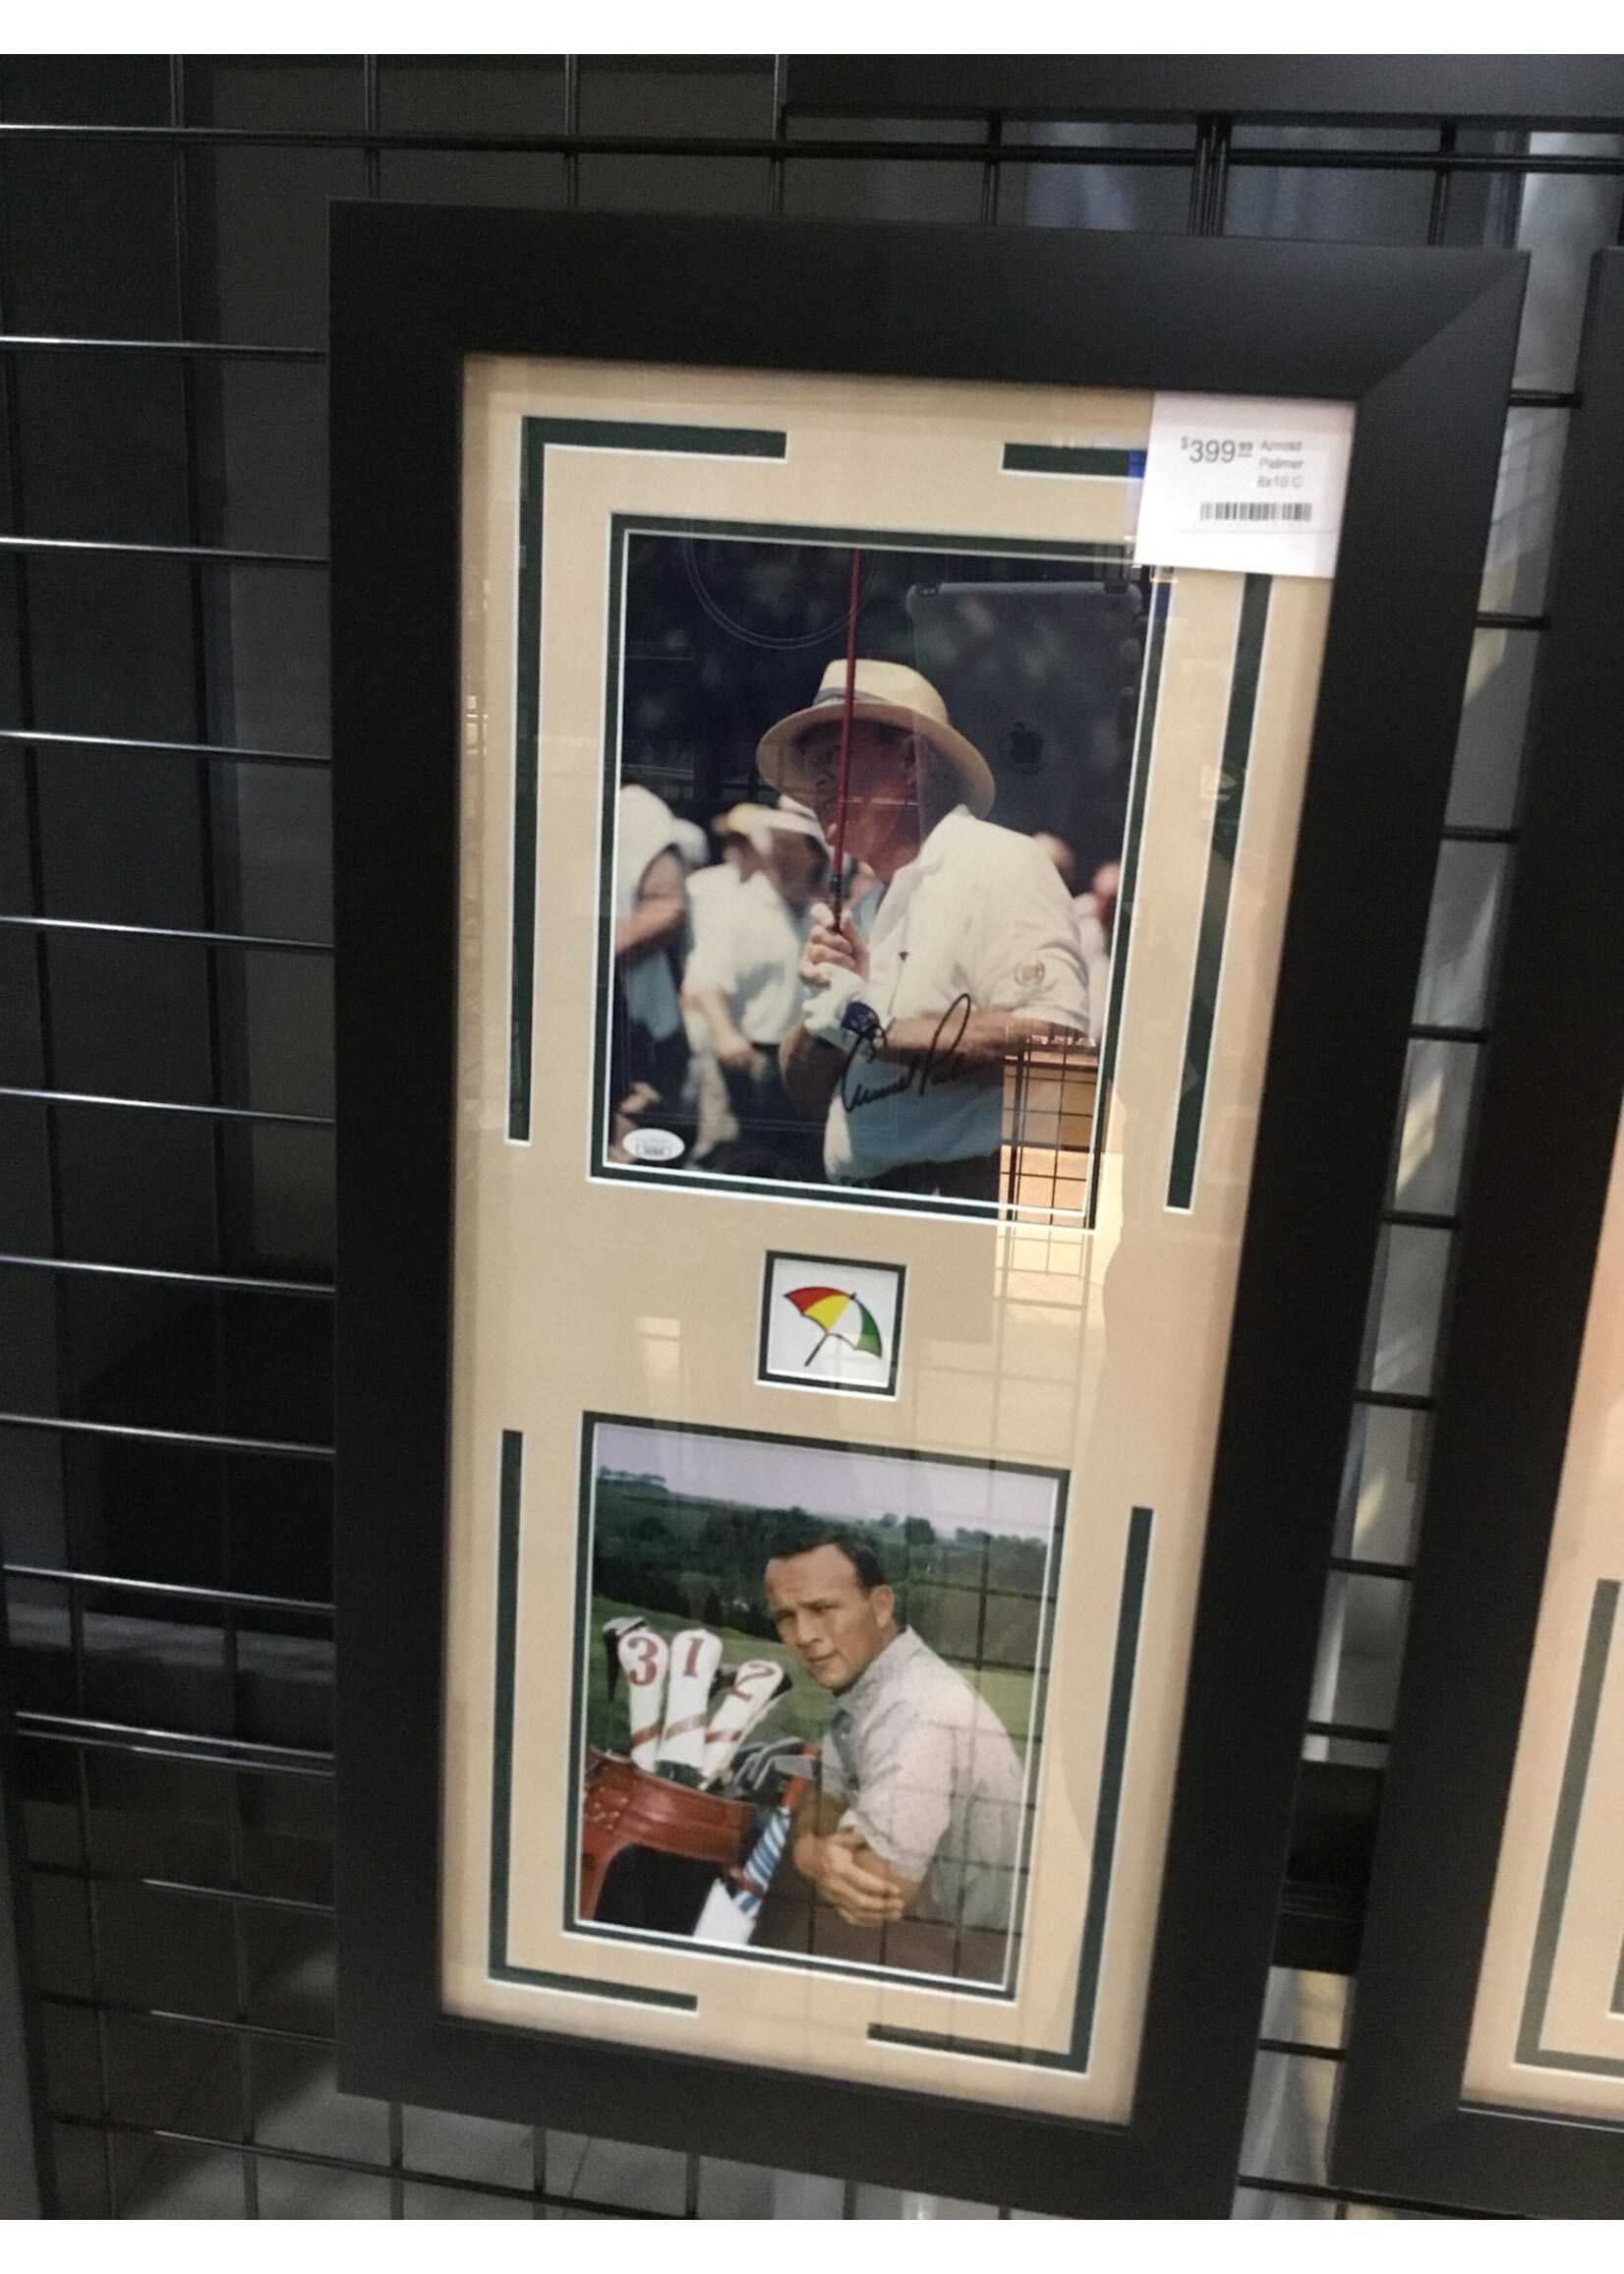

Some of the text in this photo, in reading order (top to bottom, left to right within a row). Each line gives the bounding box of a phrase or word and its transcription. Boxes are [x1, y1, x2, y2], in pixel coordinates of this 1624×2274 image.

[1260, 439, 1303, 452] Arnold
[1258, 456, 1305, 470] Palmer
[1291, 475, 1303, 489] C
[627, 1636, 776, 1703] 3 1 2
